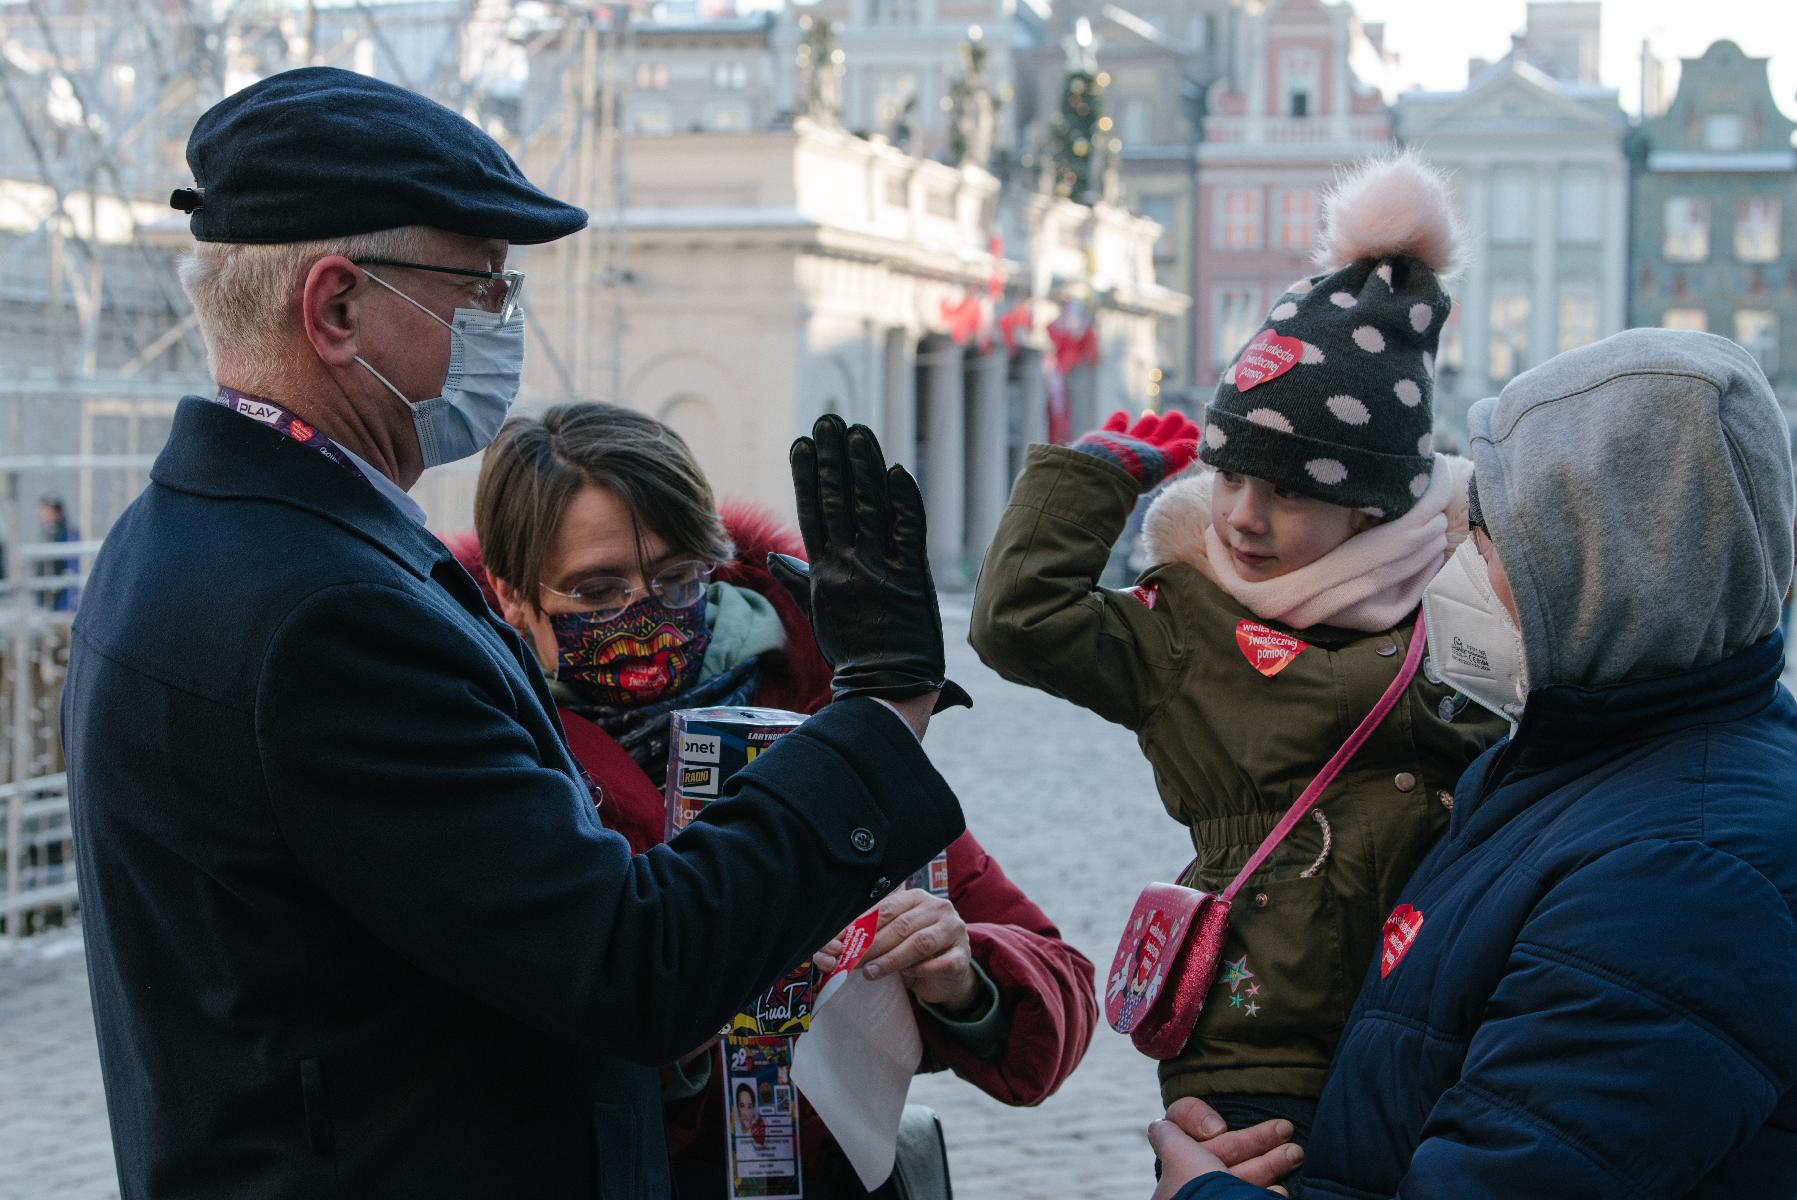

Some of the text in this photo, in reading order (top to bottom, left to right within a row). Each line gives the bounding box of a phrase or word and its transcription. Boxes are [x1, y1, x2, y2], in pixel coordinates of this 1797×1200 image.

[1238, 367, 1265, 384] pomocy
[240, 402, 277, 418] PLAY
[1243, 623, 1270, 635] wielka
[1248, 632, 1298, 651] świątecznej
[1257, 647, 1289, 663] pomocy
[684, 770, 709, 783] RADIO
[731, 1047, 747, 1071] 29
